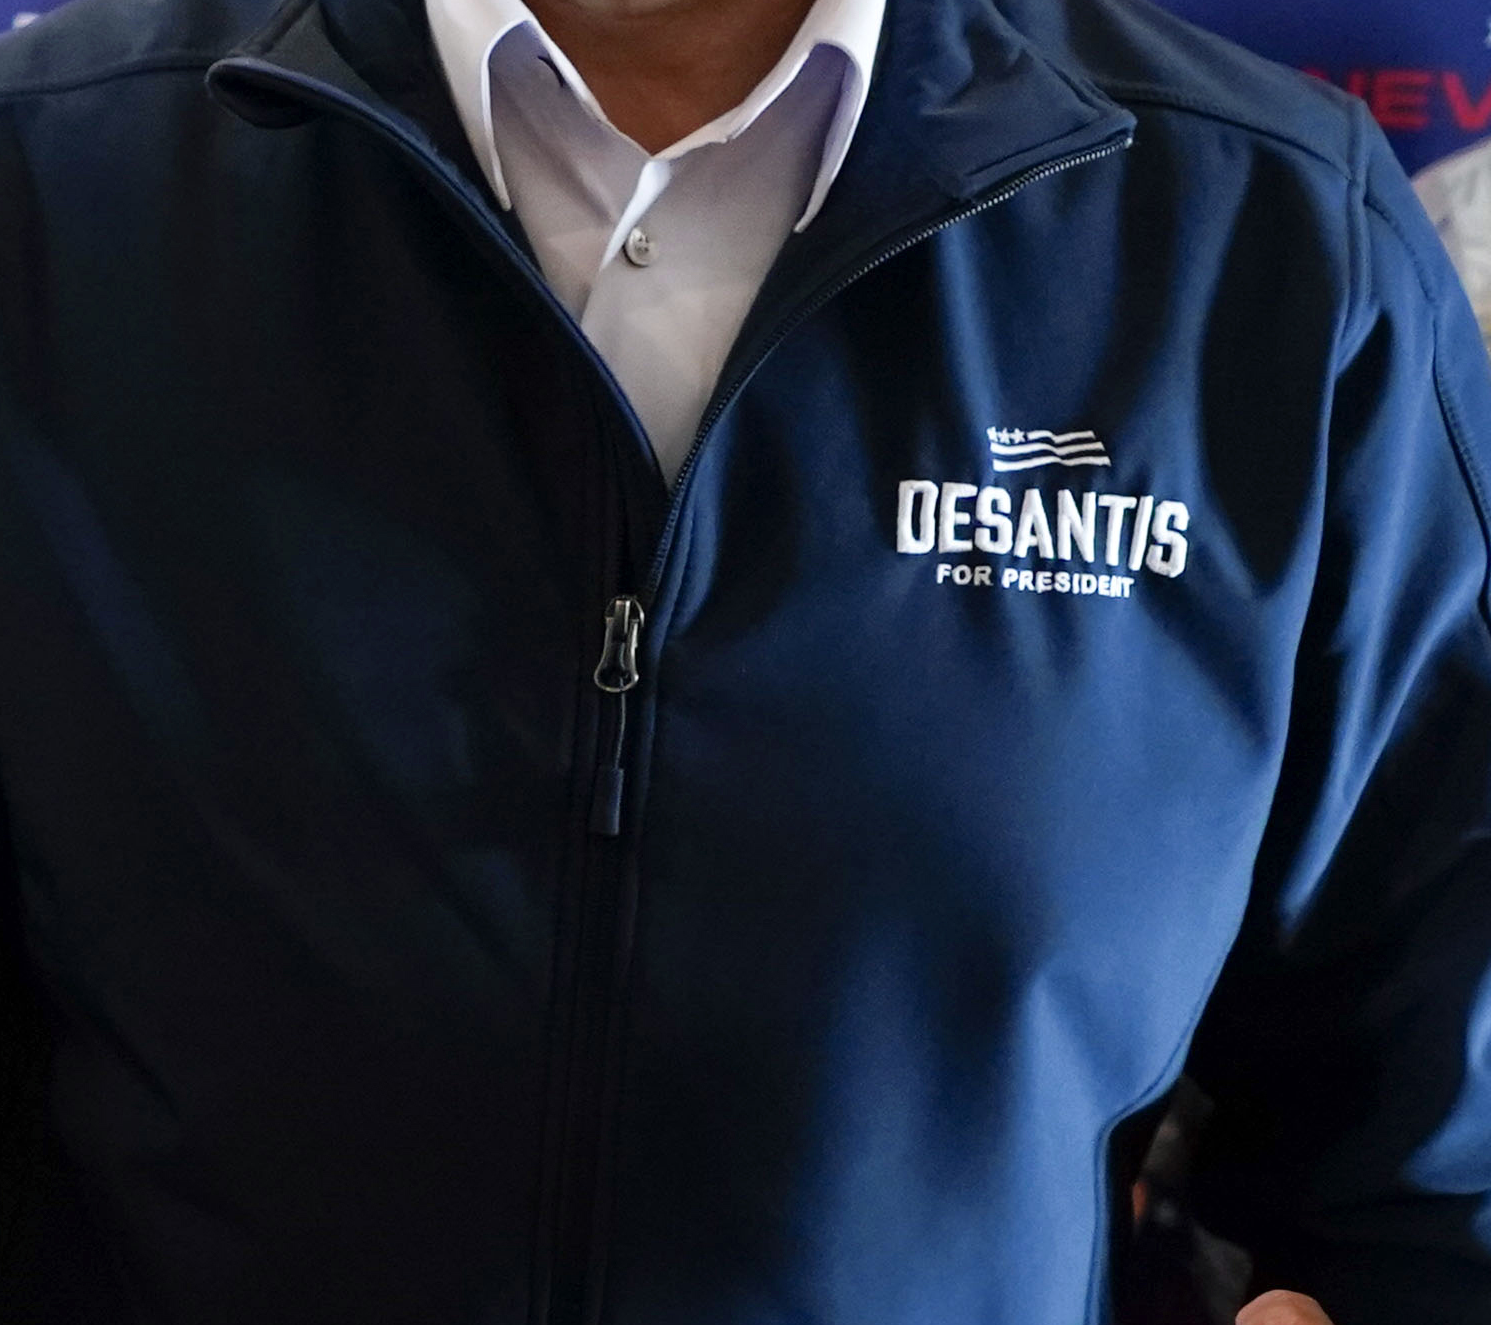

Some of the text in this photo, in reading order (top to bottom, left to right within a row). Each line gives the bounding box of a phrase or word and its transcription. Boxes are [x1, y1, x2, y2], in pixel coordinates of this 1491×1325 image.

[896, 479, 1191, 578] DESANTIS
[936, 563, 1136, 599] FOR PRESIDENT
